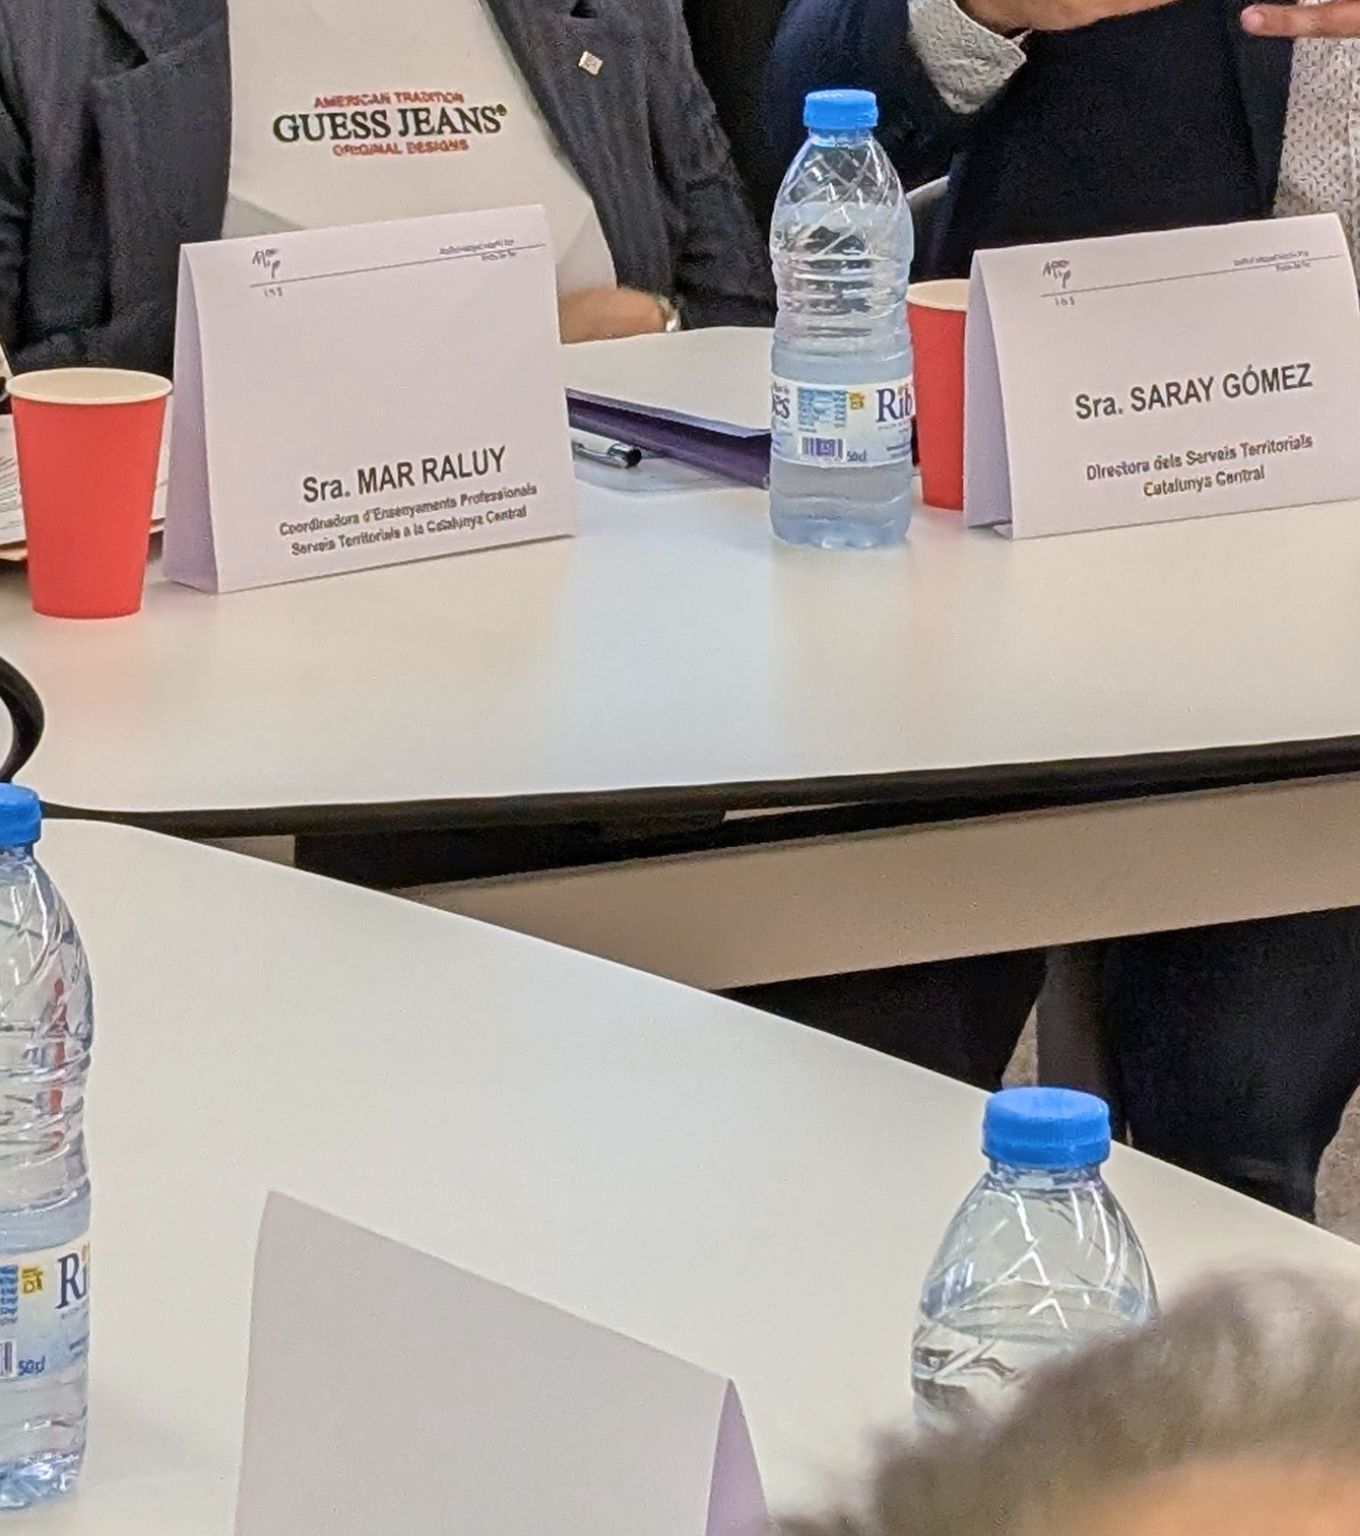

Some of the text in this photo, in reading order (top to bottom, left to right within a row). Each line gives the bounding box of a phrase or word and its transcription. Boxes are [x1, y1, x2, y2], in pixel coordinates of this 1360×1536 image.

[313, 91, 465, 108] AMERICAN TRADITION
[272, 112, 391, 143] GUESS
[332, 138, 469, 157] ORIGINAL DESIGNS
[1075, 363, 1314, 420] Sra. SARAY GÓMEZ
[303, 445, 506, 503] Sra. MAR RALUY
[1086, 434, 1314, 481] Directora dels Serveis Territorials
[1144, 465, 1266, 498] Catalunya Central
[279, 514, 360, 536] Coordinadora
[460, 482, 538, 507] Professionals
[291, 538, 336, 555] Serveis
[338, 526, 401, 549] Territorials
[413, 523, 424, 536] la
[427, 514, 484, 534] Catalunya
[486, 505, 528, 524] Central
